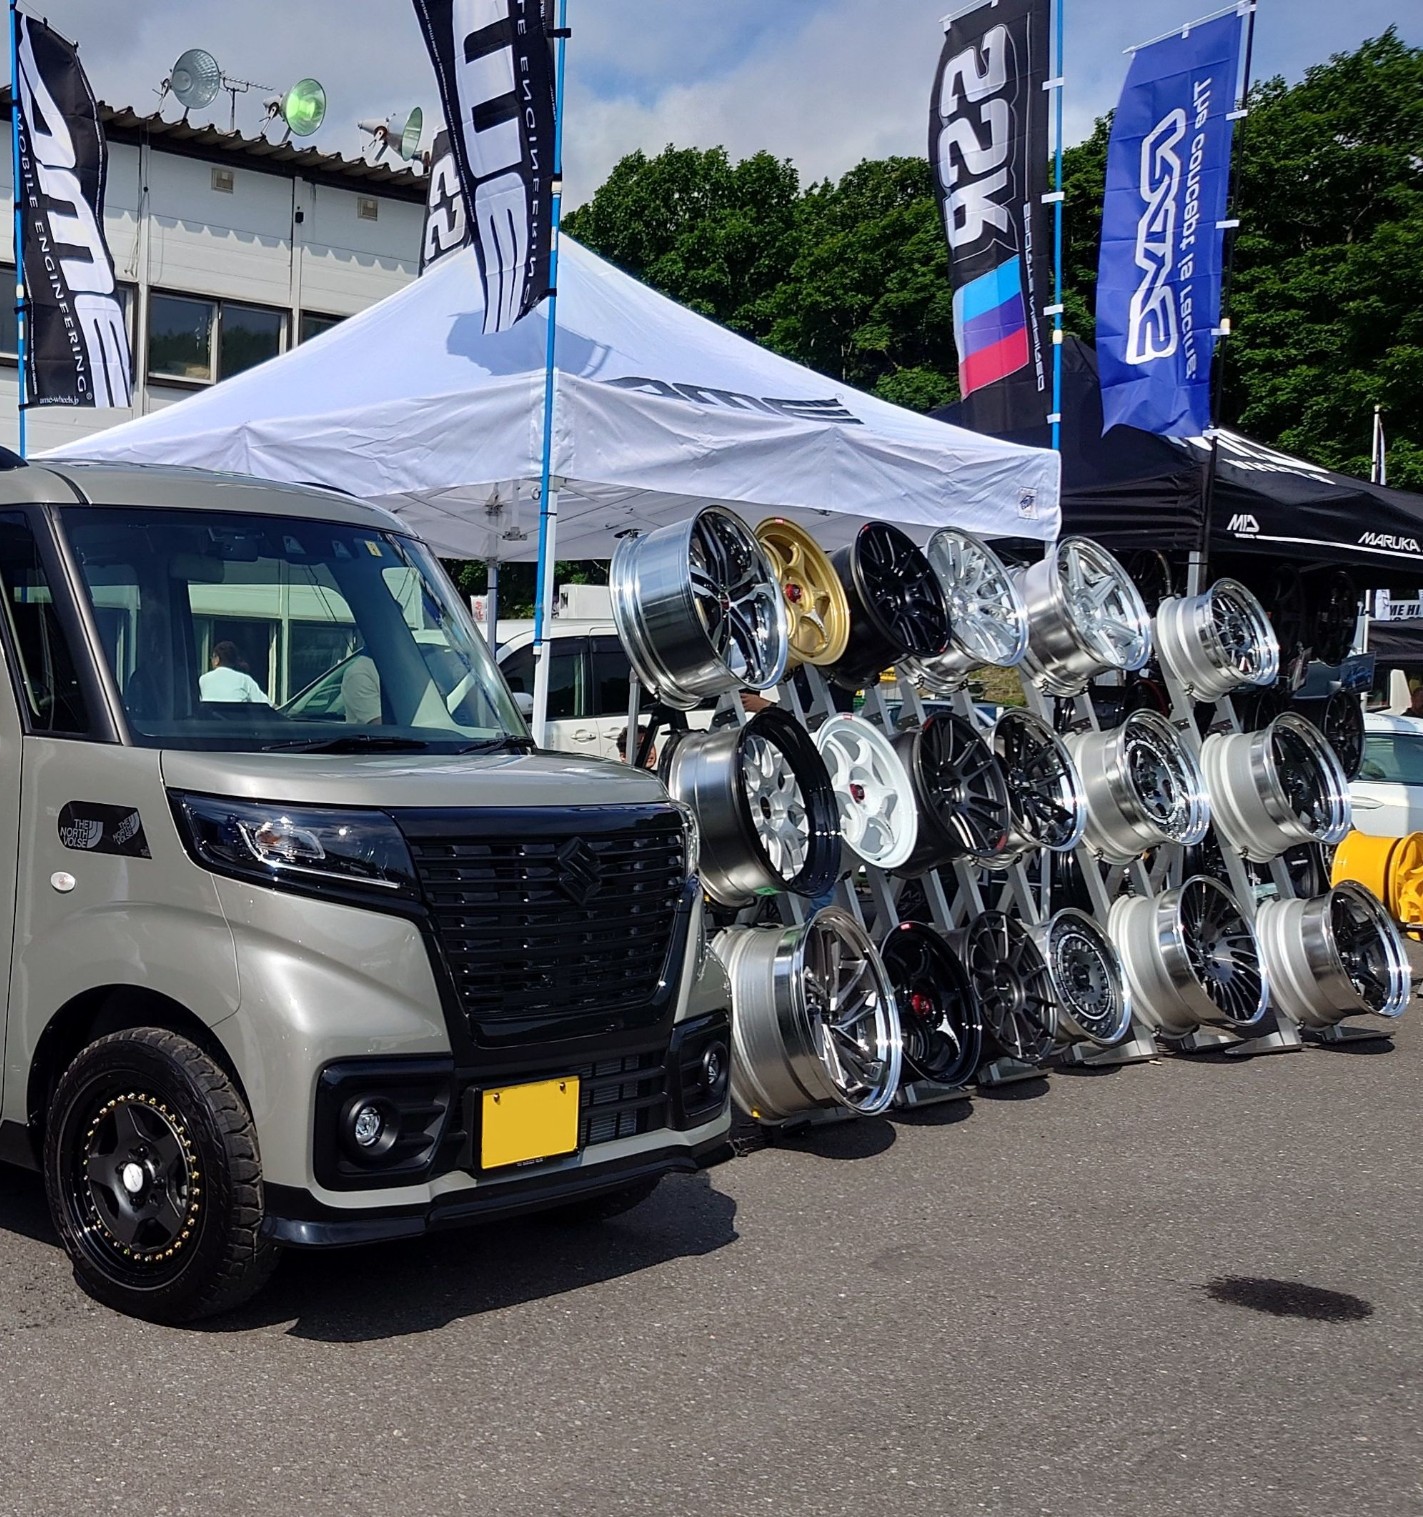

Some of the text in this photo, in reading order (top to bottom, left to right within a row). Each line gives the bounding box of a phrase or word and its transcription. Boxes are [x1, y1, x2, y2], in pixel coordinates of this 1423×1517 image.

[15, 112, 88, 394] MOBILE ENGINEERING
[1357, 531, 1422, 553] MARUKA
[74, 819, 90, 830] THE
[60, 826, 89, 838] NORTH
[62, 837, 87, 849] VOLSE
